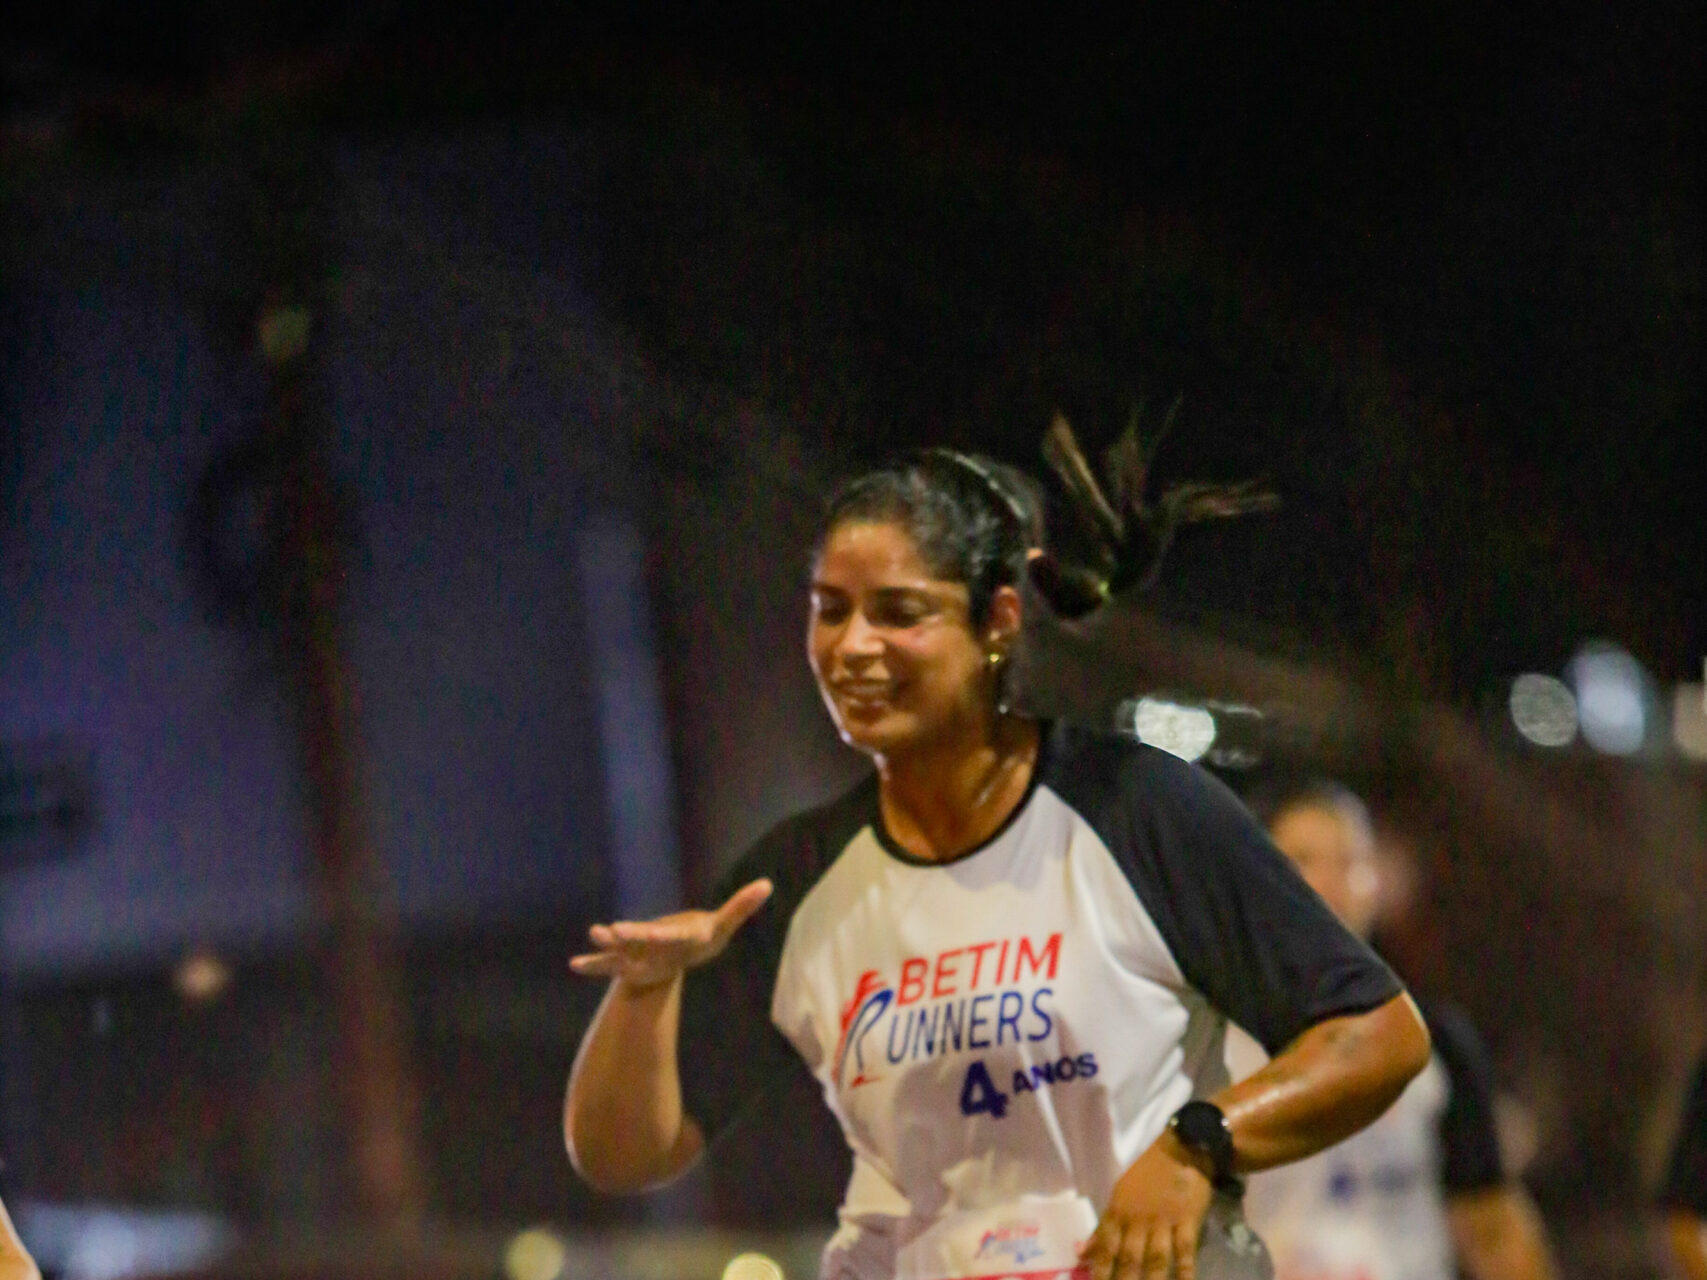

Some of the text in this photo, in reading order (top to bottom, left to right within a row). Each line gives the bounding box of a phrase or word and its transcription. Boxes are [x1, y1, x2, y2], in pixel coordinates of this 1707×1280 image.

[897, 932, 1063, 1006] BETIM
[959, 1053, 1099, 1119] 4 ANOS
